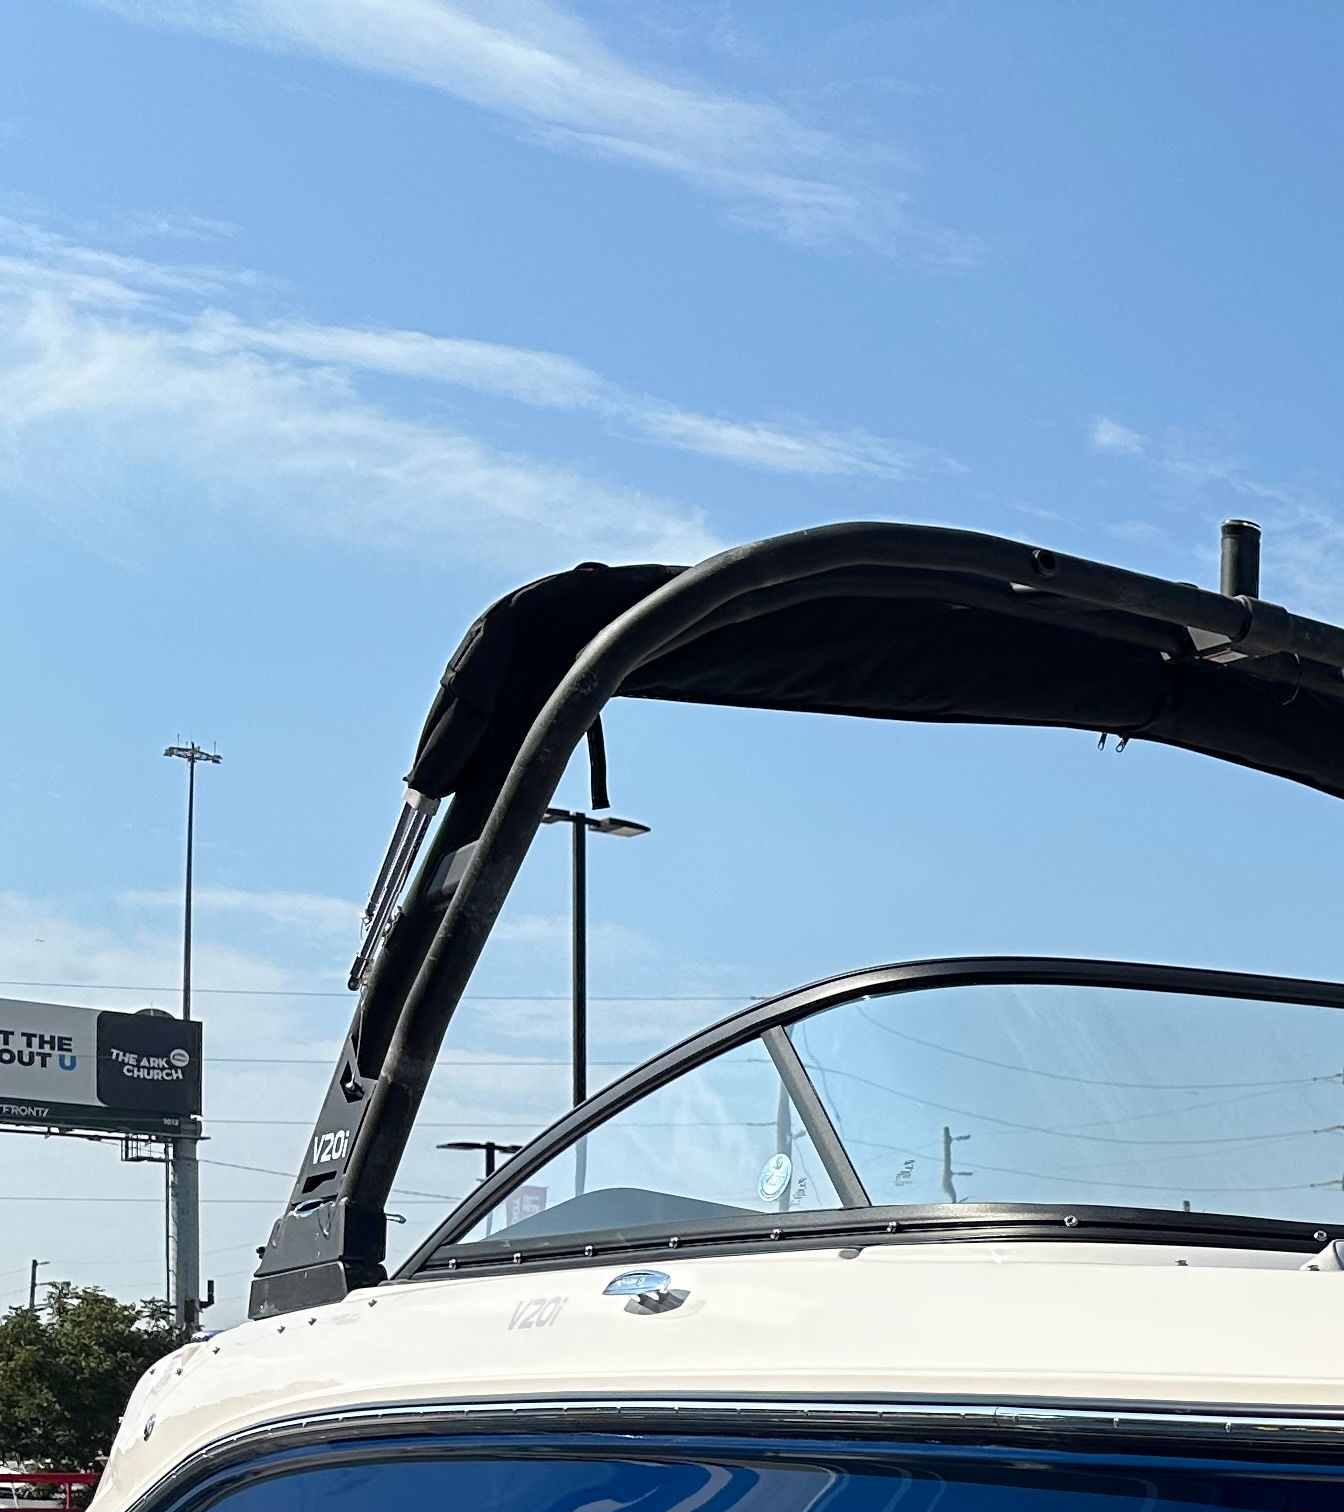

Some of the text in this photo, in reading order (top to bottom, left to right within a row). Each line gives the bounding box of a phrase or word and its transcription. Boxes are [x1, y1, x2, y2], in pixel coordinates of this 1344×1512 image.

[20, 1032, 73, 1053] THE
[58, 1054, 77, 1071] U
[111, 1048, 169, 1068] THE ARK
[123, 1065, 184, 1080] CHURCH
[312, 1130, 350, 1164] V20i
[507, 1296, 570, 1330] V20i
